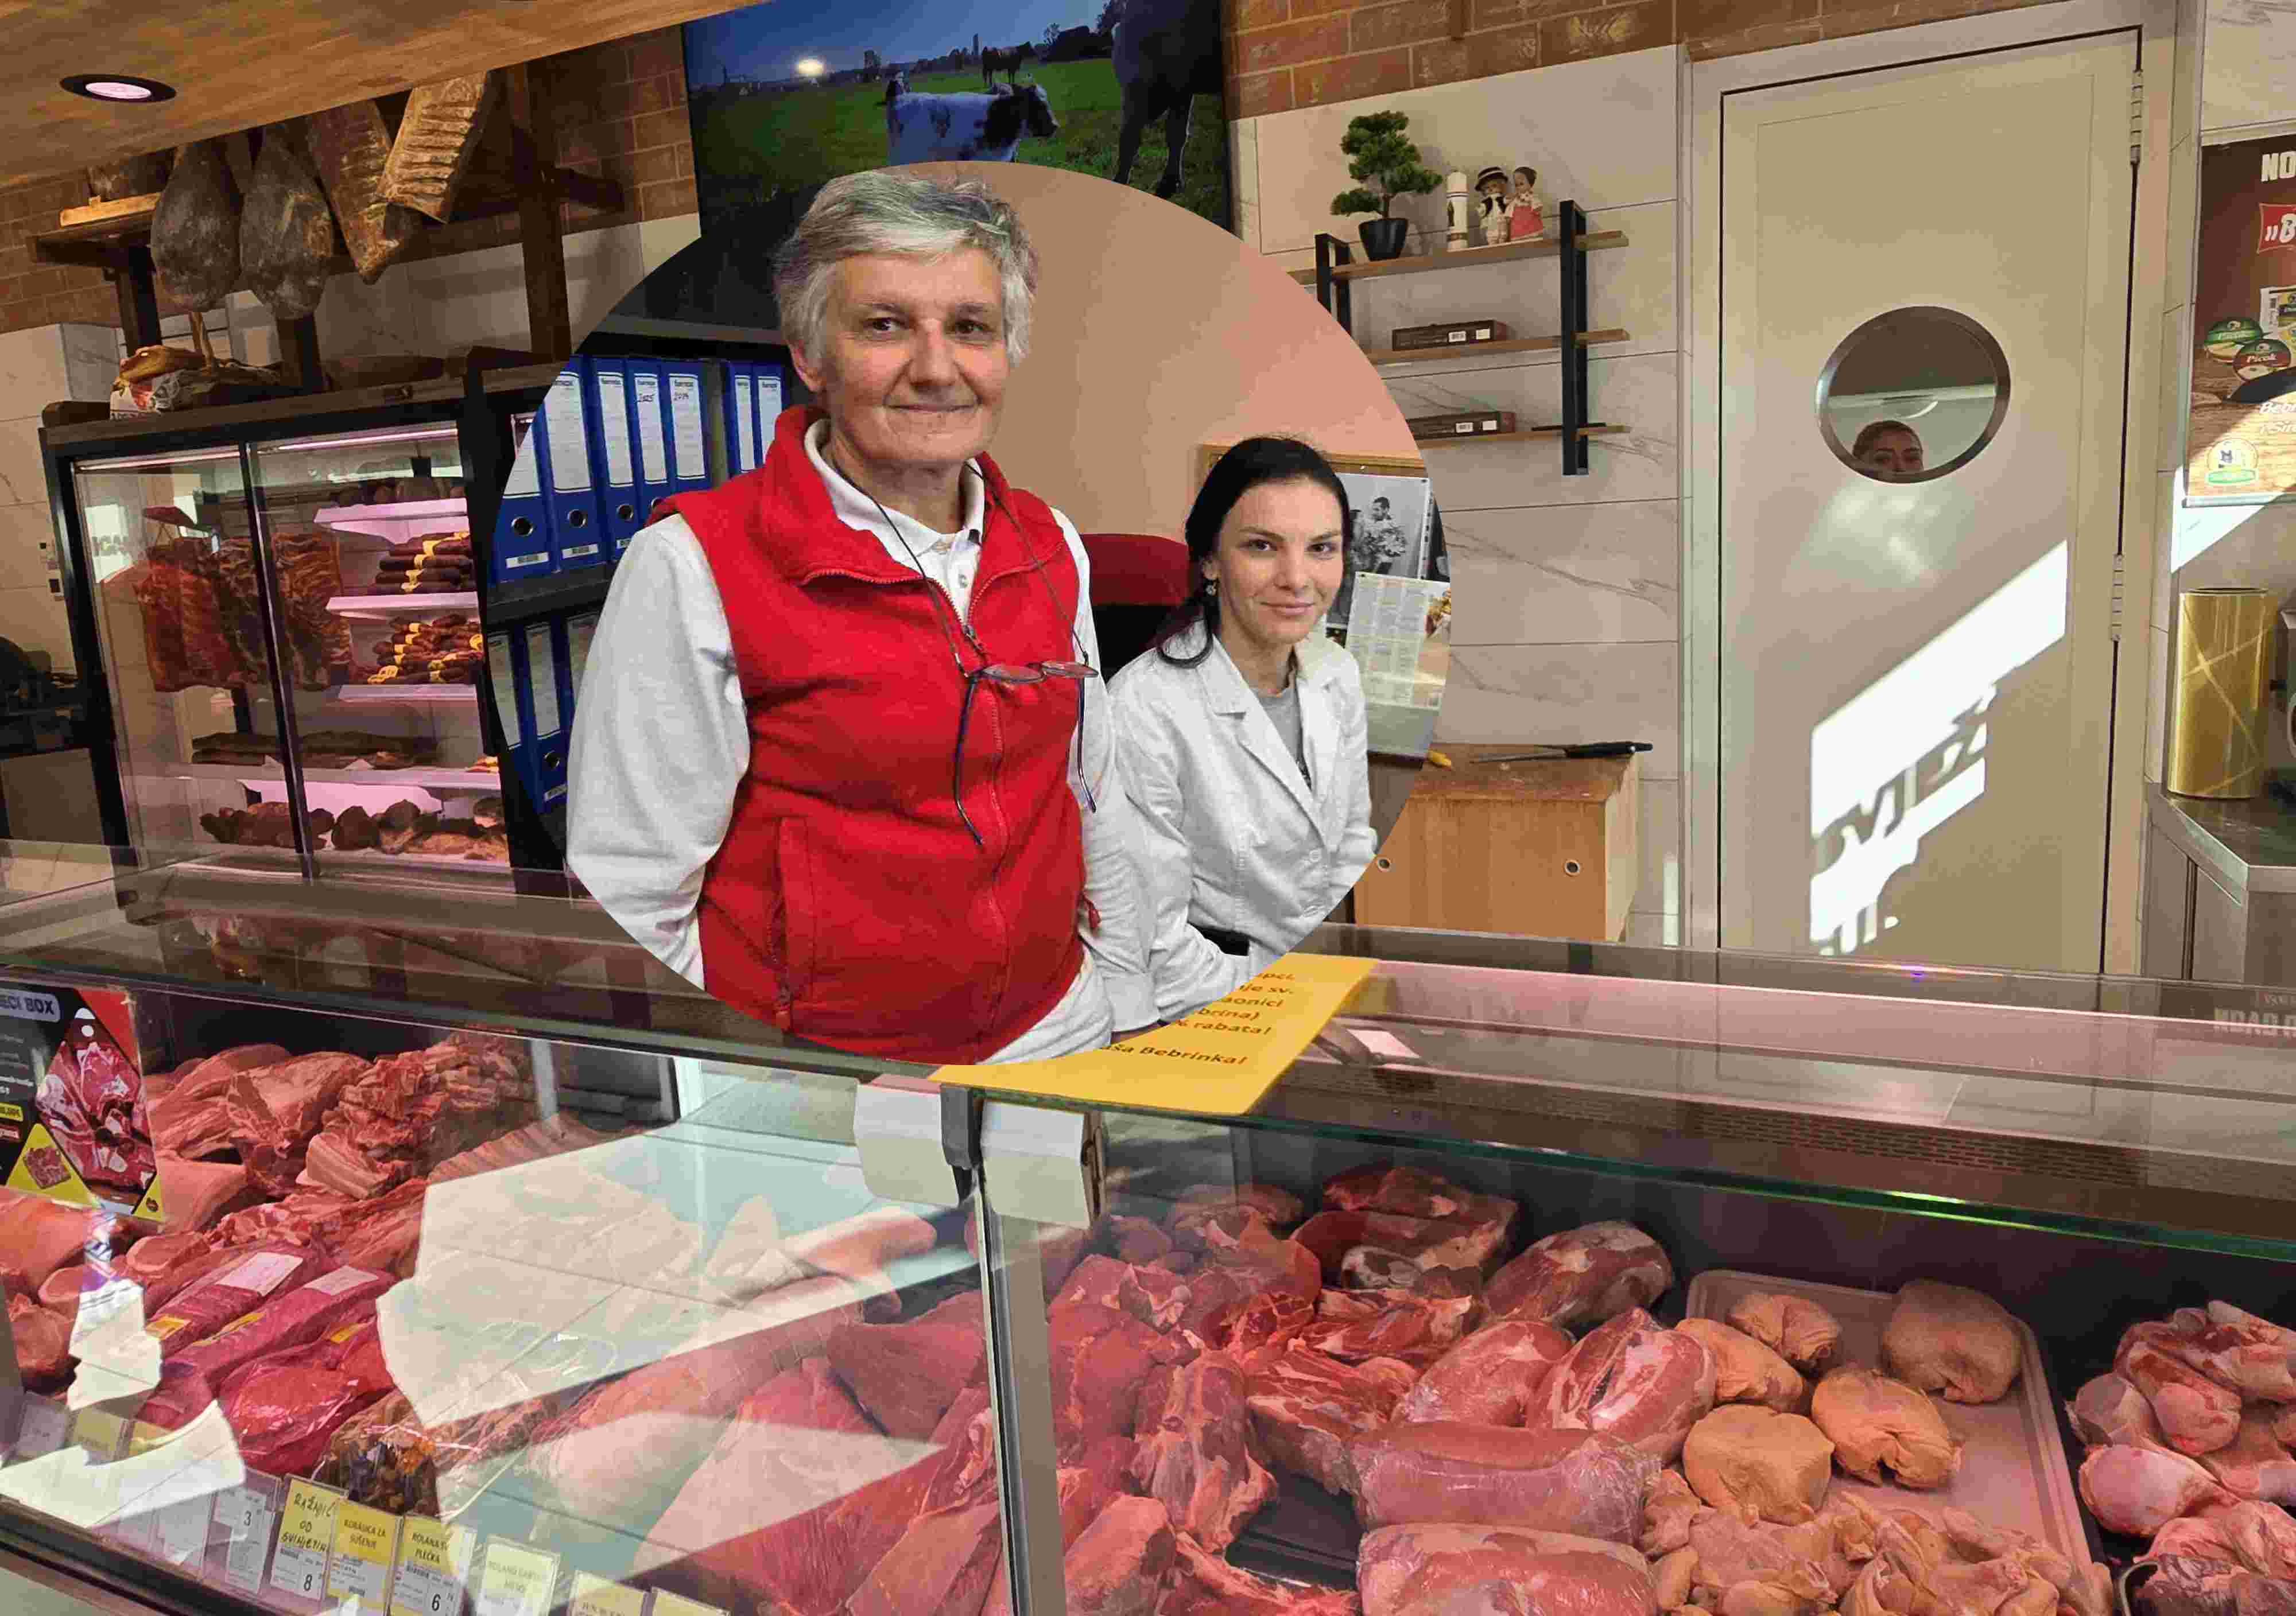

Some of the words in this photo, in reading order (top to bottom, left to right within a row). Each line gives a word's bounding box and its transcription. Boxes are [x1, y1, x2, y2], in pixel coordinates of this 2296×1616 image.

[24, 996, 55, 1015] BOX
[299, 1519, 313, 1533] OD
[304, 1574, 313, 1592] 8
[431, 1593, 442, 1612] 6
